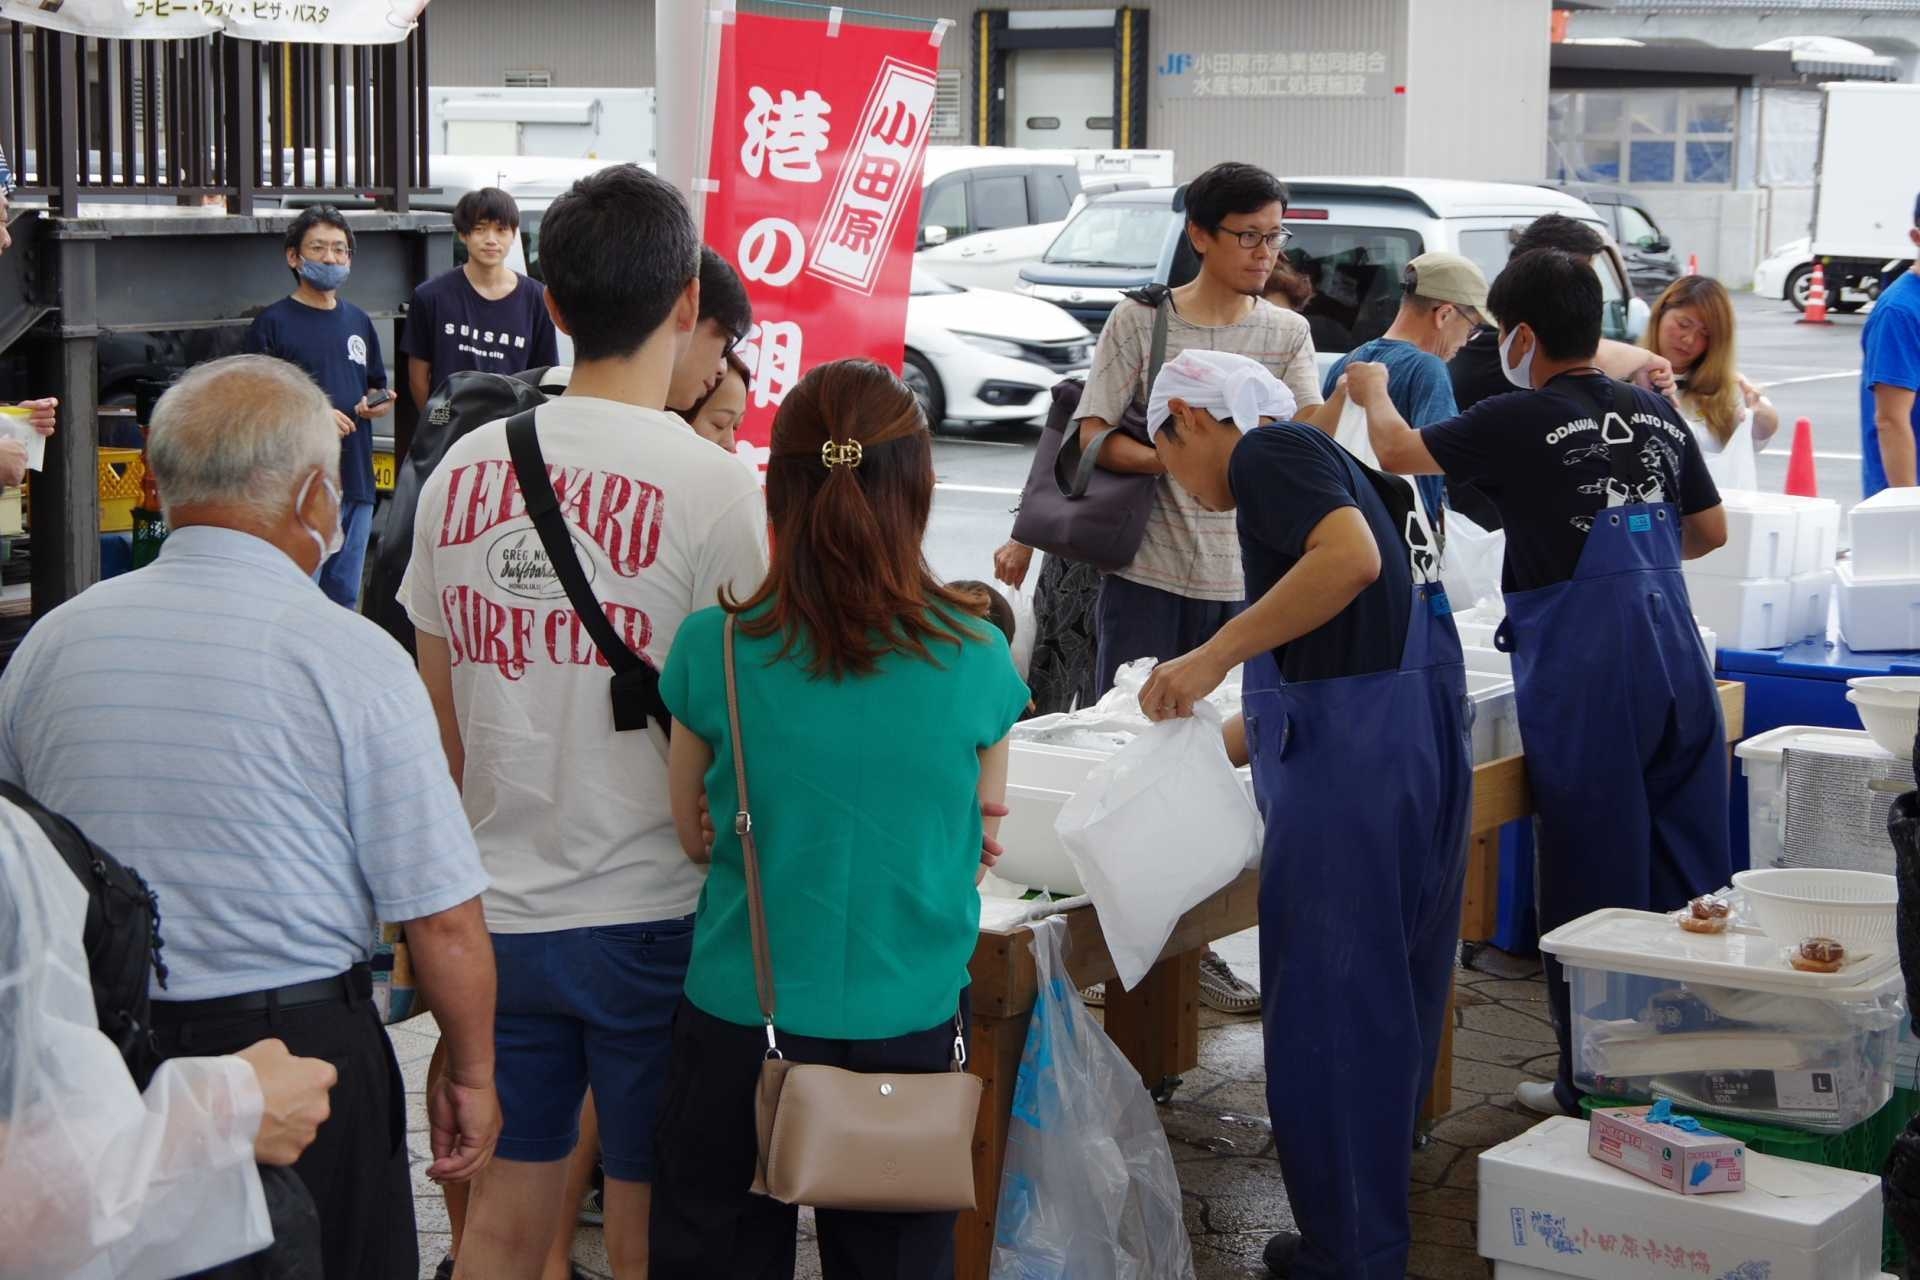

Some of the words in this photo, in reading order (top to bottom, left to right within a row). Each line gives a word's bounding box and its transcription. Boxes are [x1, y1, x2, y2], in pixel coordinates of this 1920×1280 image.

[829, 100, 917, 256] 小田原
[445, 323, 525, 348] SUISAN
[443, 585, 535, 681] SURF
